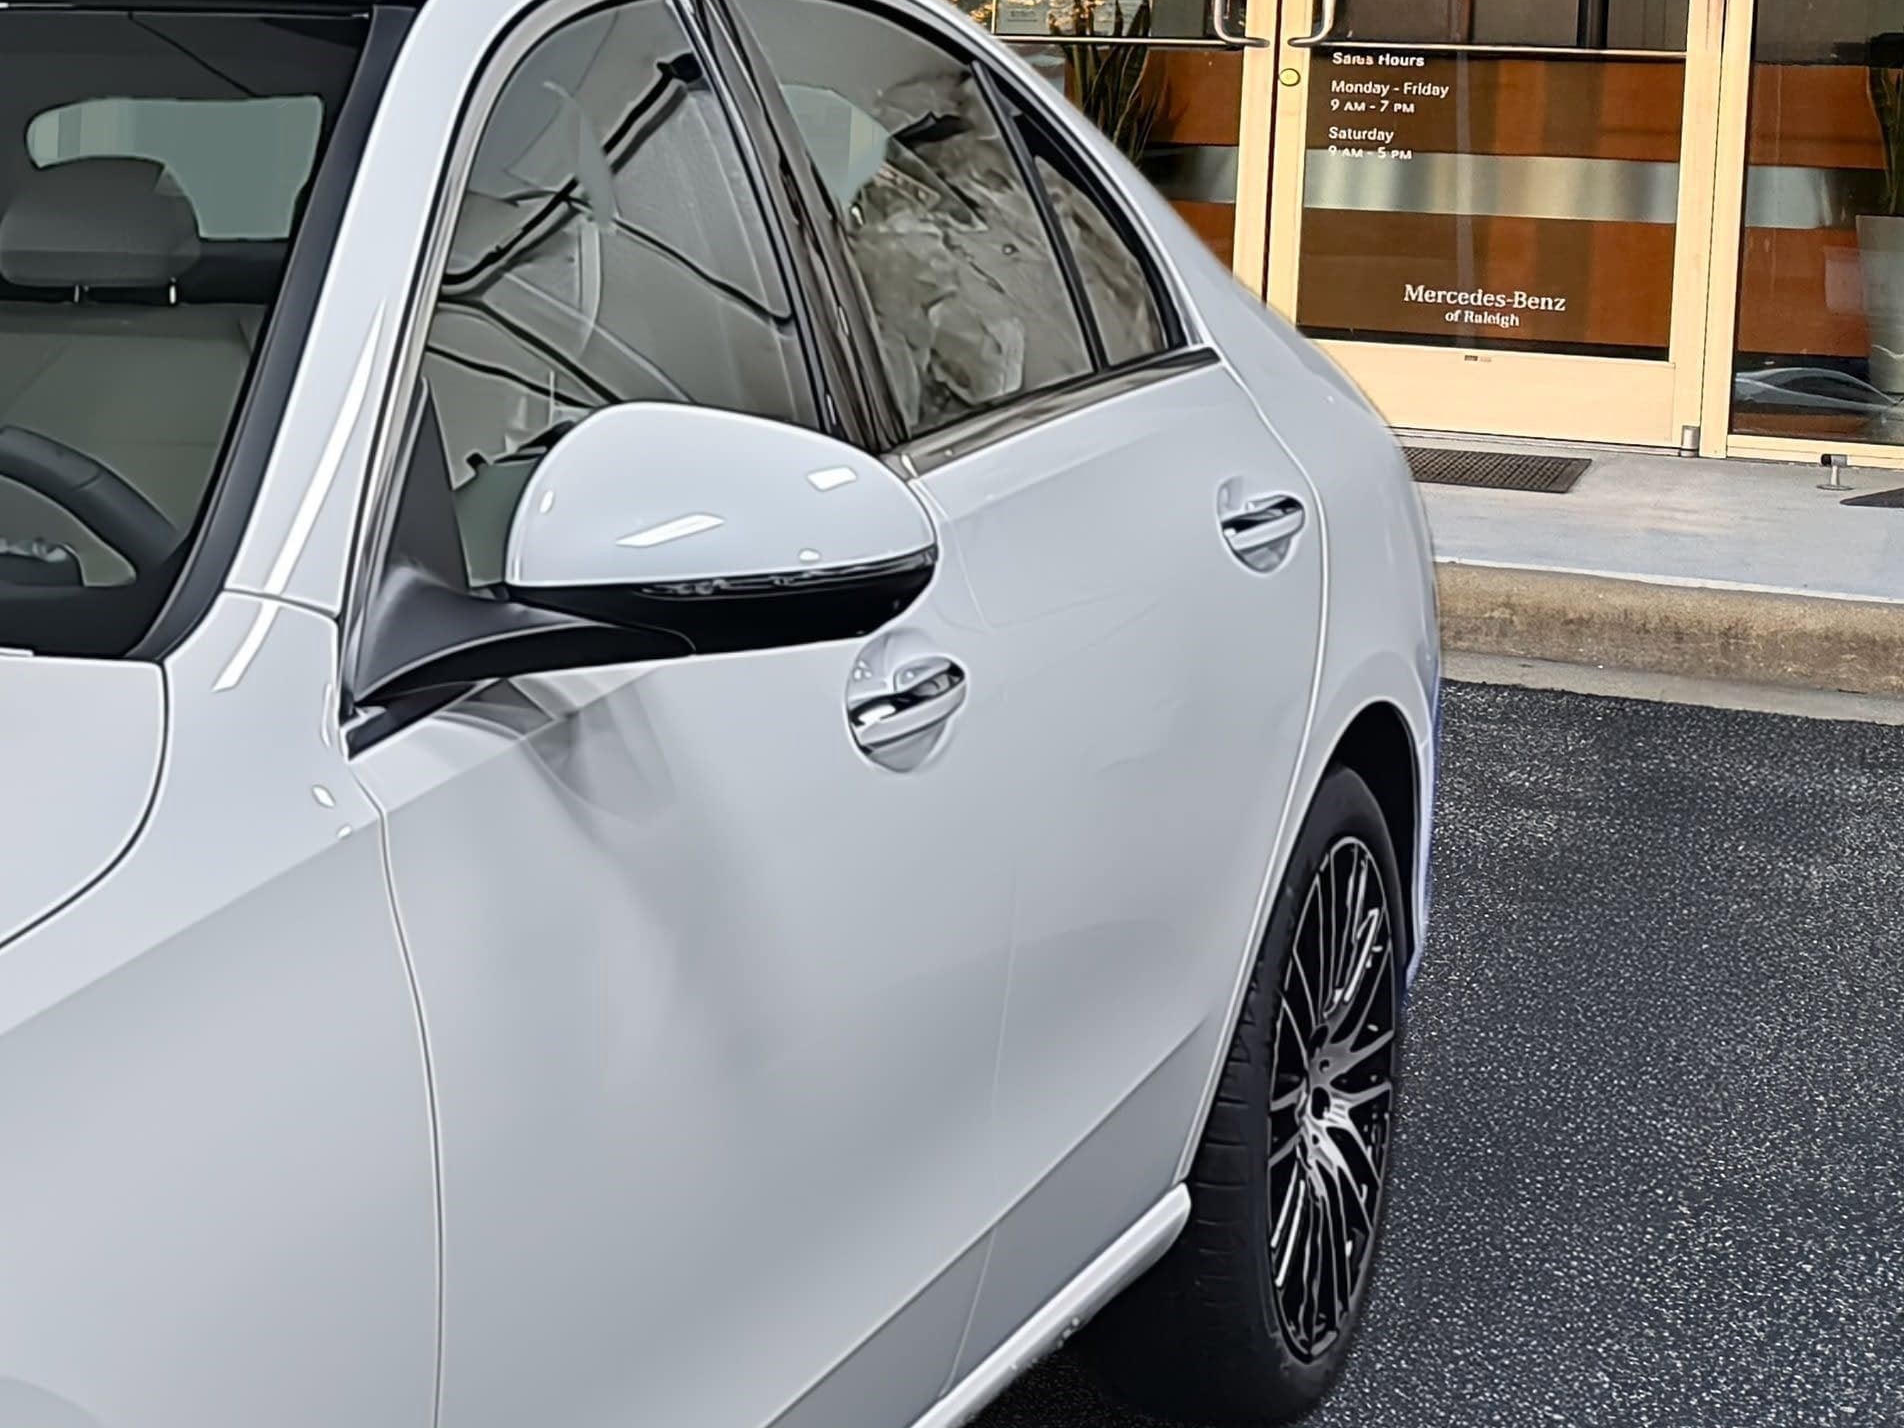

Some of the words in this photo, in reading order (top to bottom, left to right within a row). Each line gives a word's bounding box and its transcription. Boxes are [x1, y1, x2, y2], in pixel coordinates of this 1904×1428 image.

[1377, 52, 1425, 67] Hours
[1331, 79, 1390, 97] Monday
[1403, 81, 1449, 99] Friday
[1330, 99, 1340, 111] 9
[1343, 100, 1366, 112] AM
[1379, 100, 1389, 112] 7
[1393, 102, 1415, 113] PM
[1328, 126, 1394, 144] Saturday
[1328, 145, 1338, 158] 9
[1341, 147, 1364, 159] AM
[1377, 146, 1387, 159] 5
[1391, 149, 1413, 160] PM
[1403, 283, 1566, 312] Mercedes-Benz
[1444, 309, 1460, 323] of
[1463, 310, 1520, 329] Raleigh
